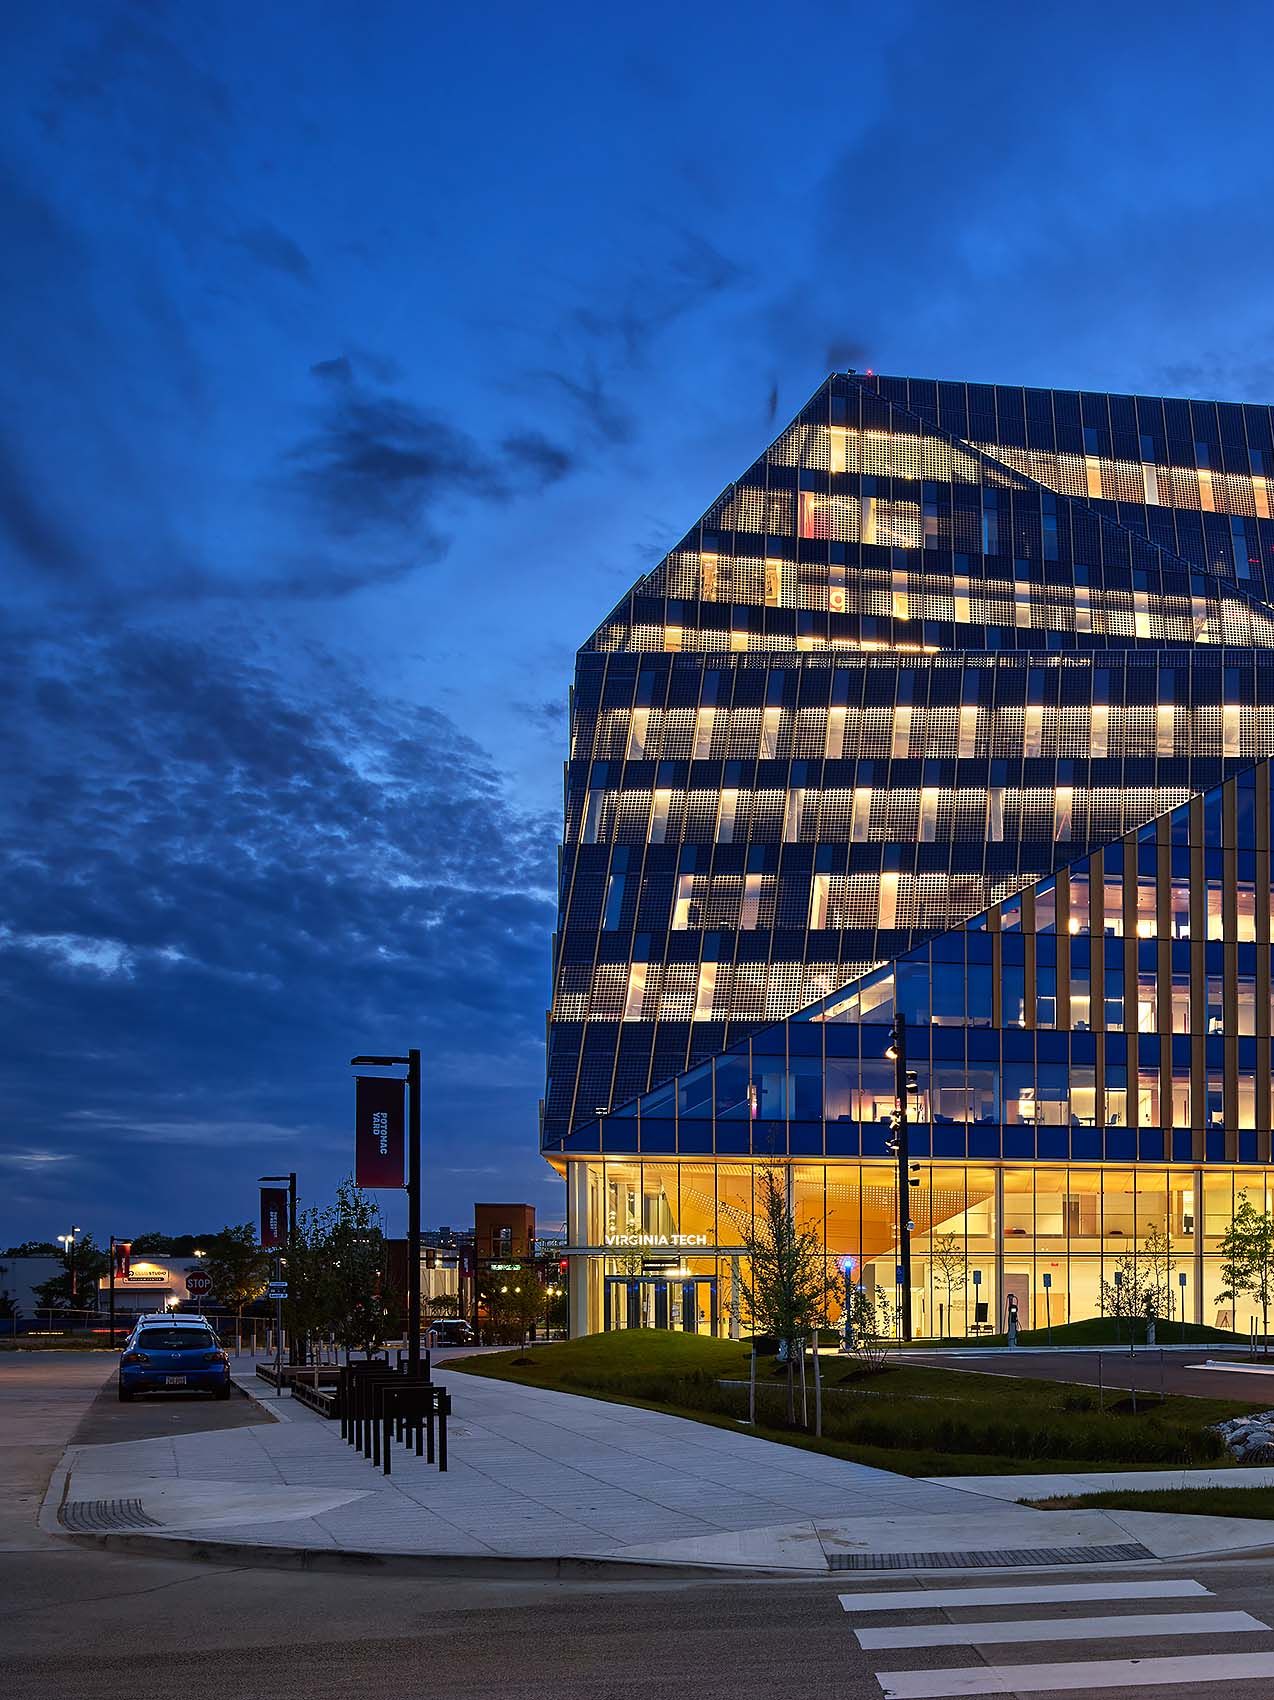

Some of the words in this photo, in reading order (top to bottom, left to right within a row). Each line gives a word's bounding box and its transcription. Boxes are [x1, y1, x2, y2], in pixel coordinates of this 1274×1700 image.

[380, 1112, 388, 1155] POTOMAC
[604, 1234, 669, 1246] VIRGINIA
[671, 1234, 707, 1246] TECH
[187, 1279, 211, 1289] STOP
